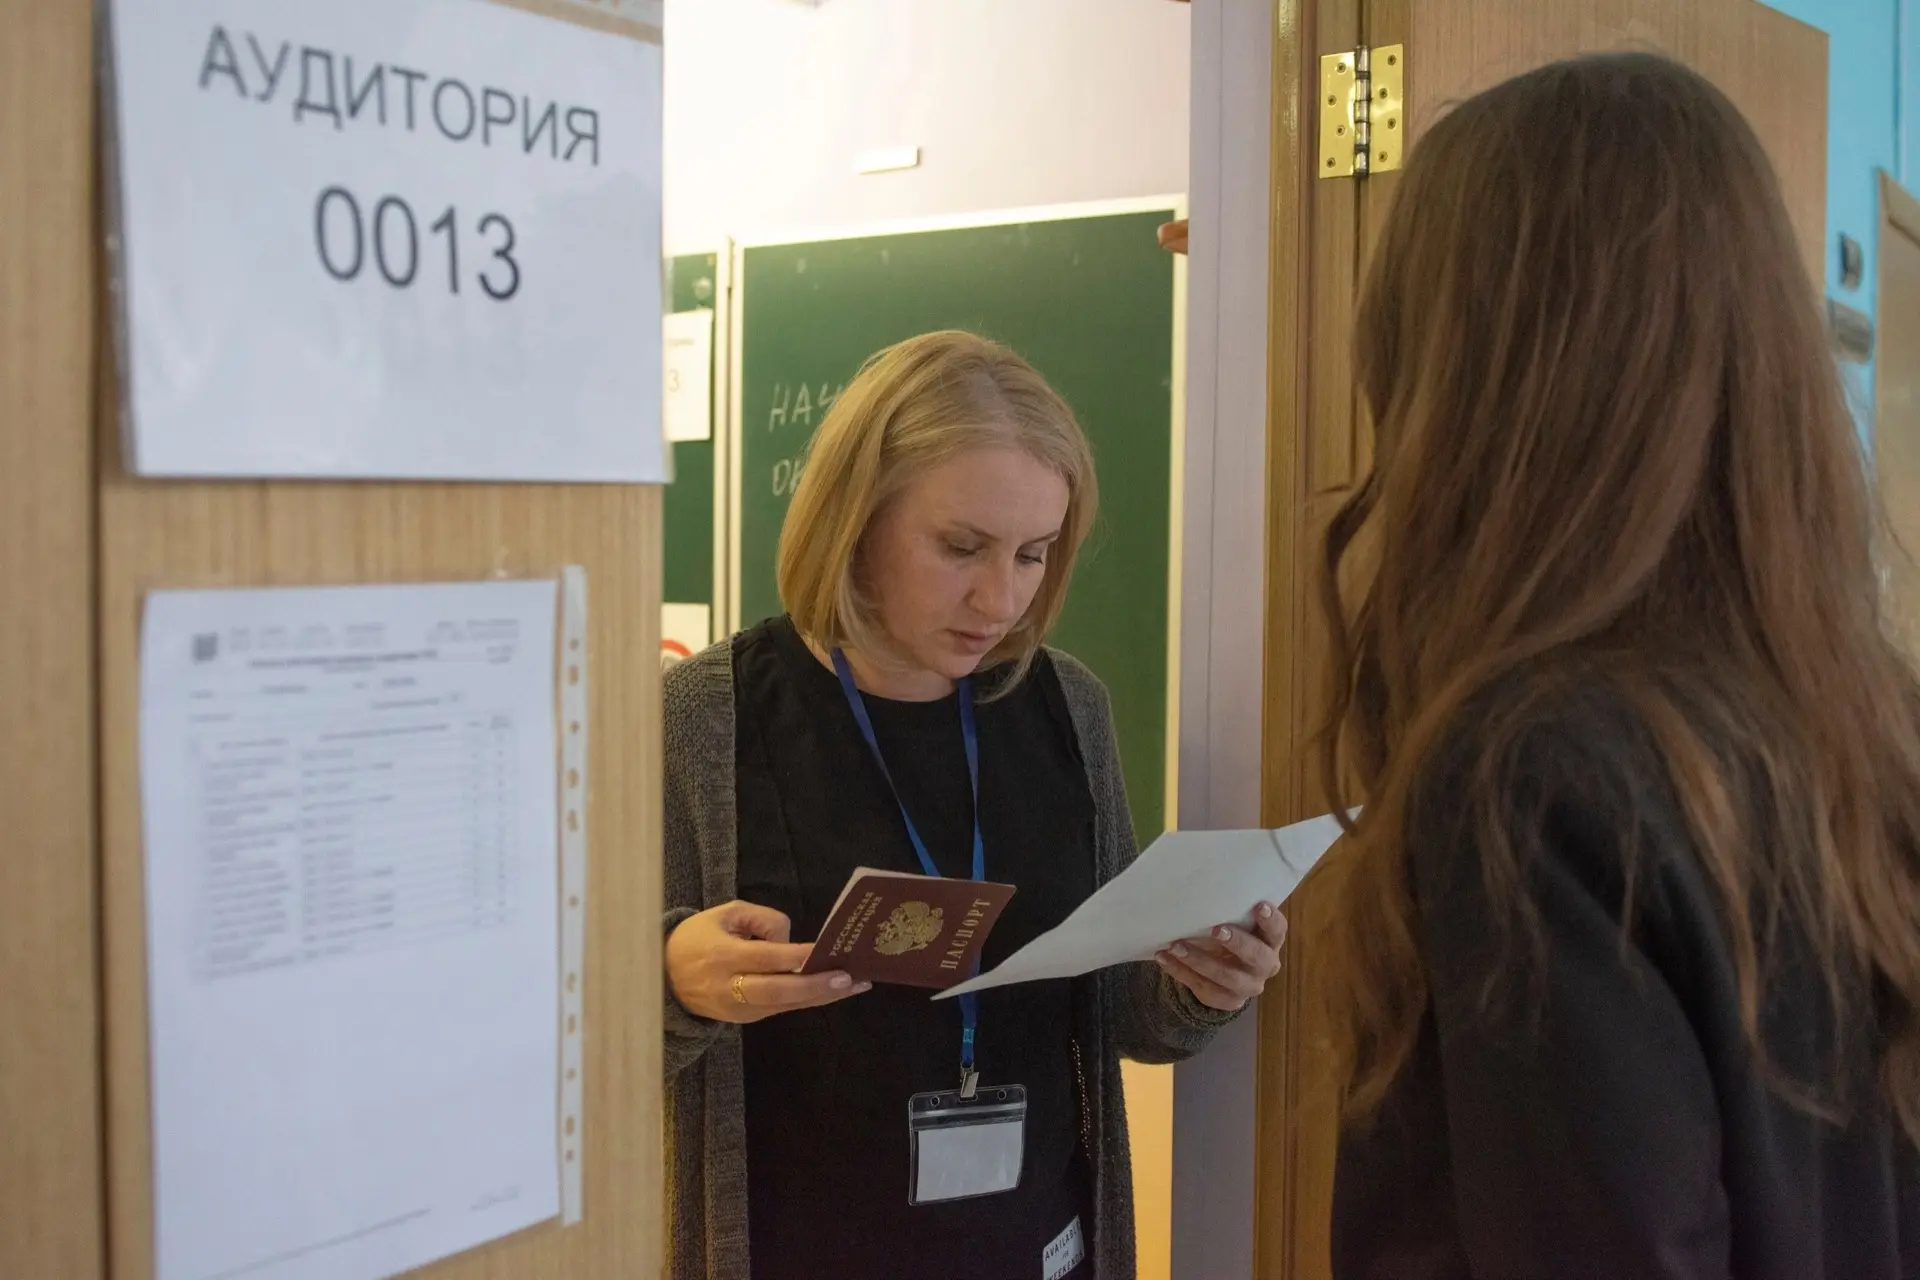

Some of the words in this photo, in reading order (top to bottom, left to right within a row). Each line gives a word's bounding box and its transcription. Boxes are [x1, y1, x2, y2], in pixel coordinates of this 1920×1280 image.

[198, 24, 598, 166] АУДИТОРИЯ
[315, 185, 520, 301] 0013
[829, 891, 874, 957] РОССИЙСКАЯ
[843, 896, 883, 953] ФЕДЕРАЦИЯ
[941, 898, 991, 970] ПАСПОРТ
